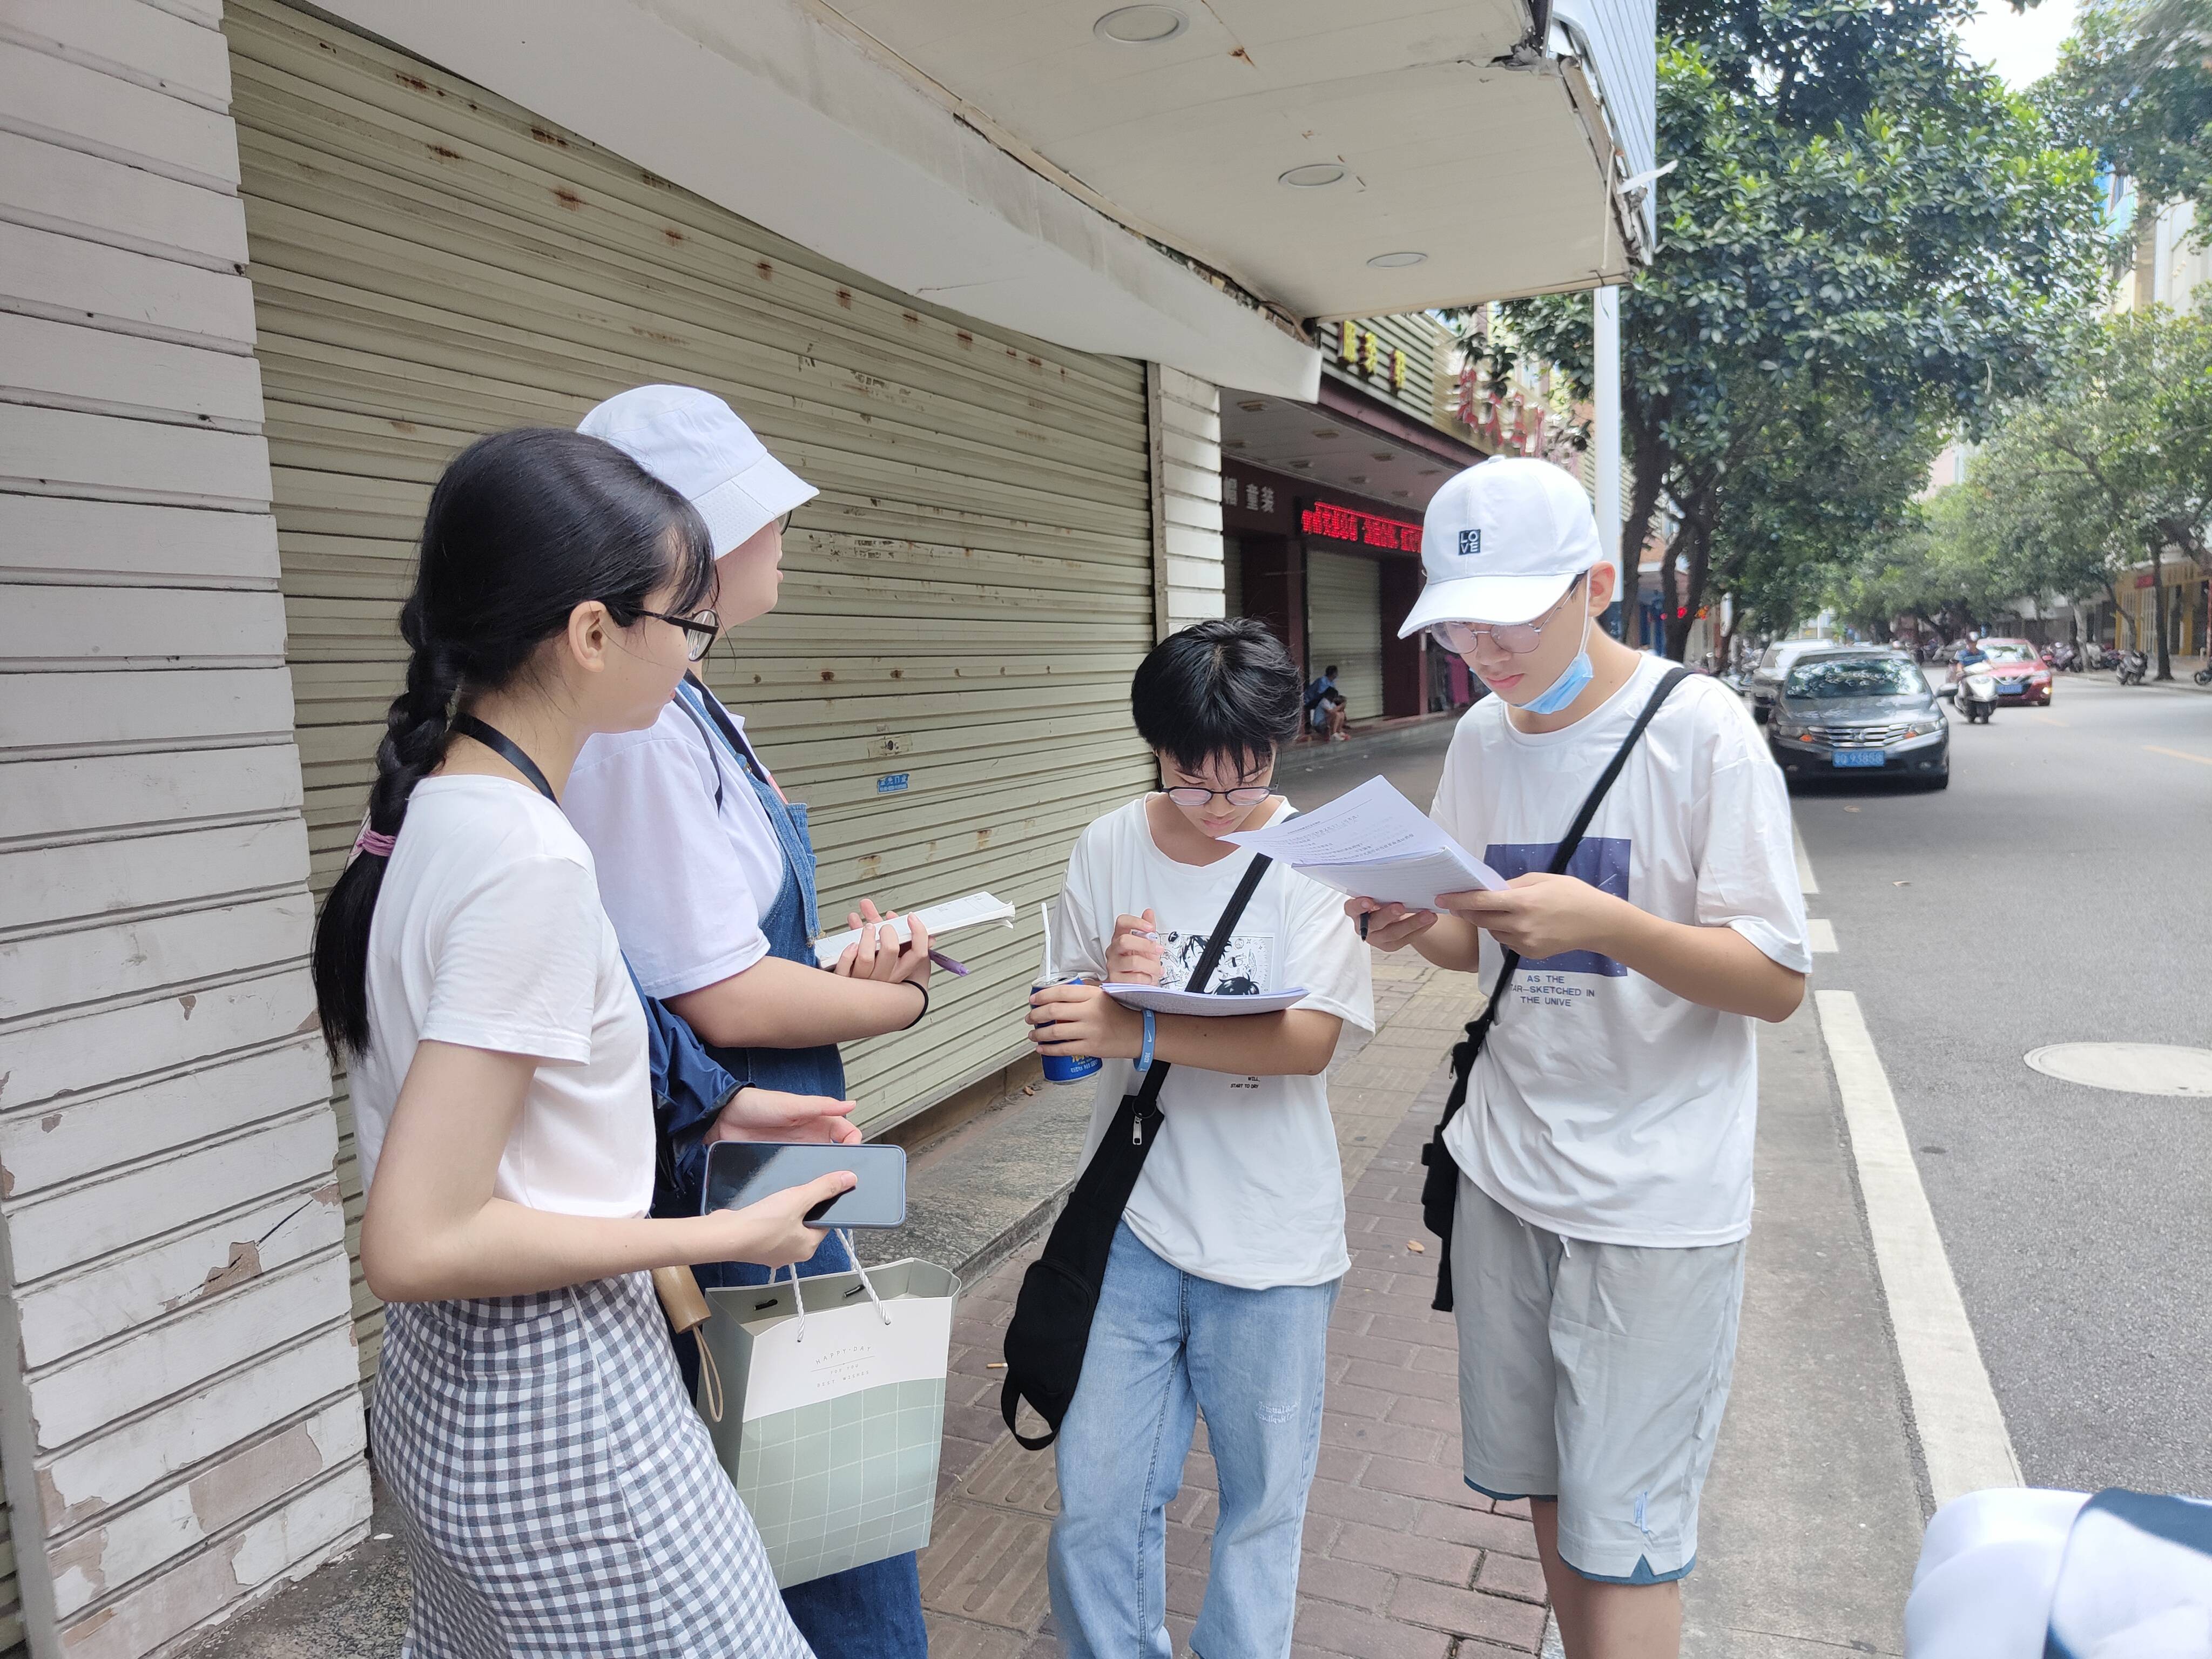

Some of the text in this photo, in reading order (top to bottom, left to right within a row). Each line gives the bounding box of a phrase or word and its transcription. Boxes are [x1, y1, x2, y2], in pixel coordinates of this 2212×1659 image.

[1546, 975, 1564, 983] THE
[1510, 984, 1595, 997] AR-SKETCHED IN
[1520, 996, 1572, 1007] THE UNIVE
[817, 1370, 869, 1387] BEST WISHES
